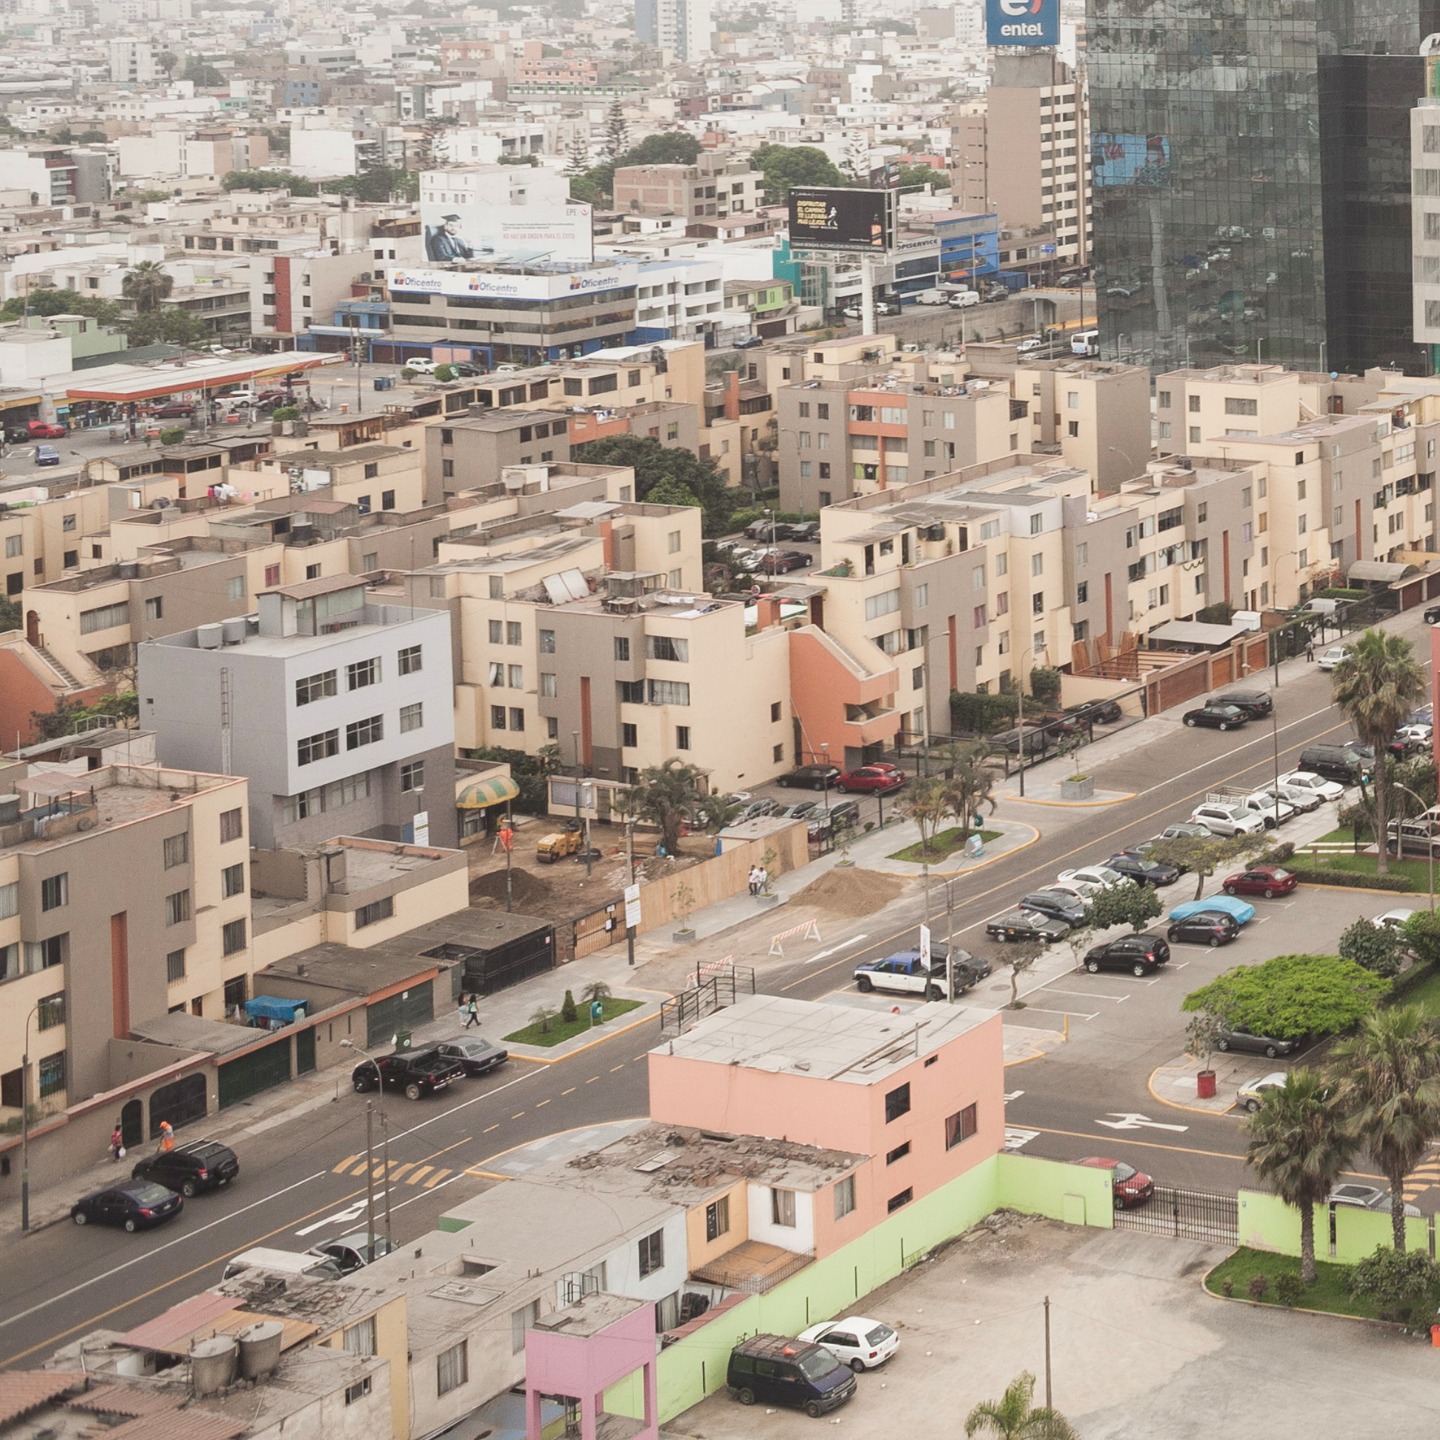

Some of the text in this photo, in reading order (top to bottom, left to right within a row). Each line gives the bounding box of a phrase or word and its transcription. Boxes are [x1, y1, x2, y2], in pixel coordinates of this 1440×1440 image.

[1000, 22, 1044, 36] entel
[566, 208, 577, 216] EPE
[404, 277, 442, 287] Oficentro
[479, 281, 518, 292] Oficentro
[581, 277, 619, 288] Oficentro
